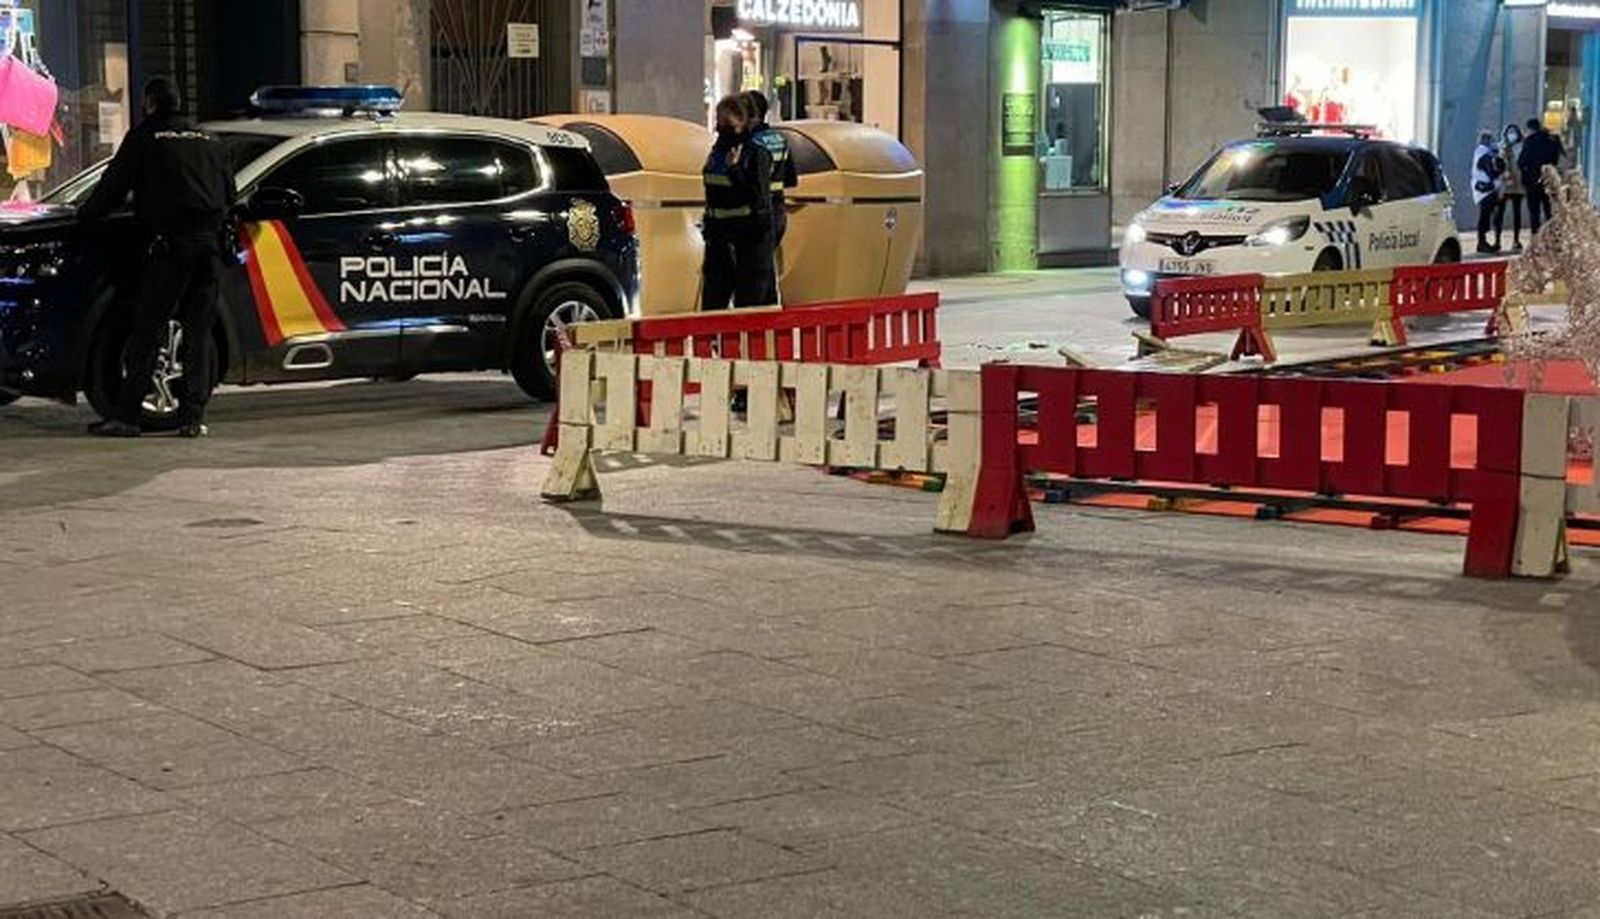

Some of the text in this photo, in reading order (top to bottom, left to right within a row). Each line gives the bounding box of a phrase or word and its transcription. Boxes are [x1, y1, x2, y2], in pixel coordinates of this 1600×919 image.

[737, 0, 860, 27] CALZEDONIA
[339, 252, 469, 278] POLICÍA
[339, 278, 507, 303] NACIONAL
